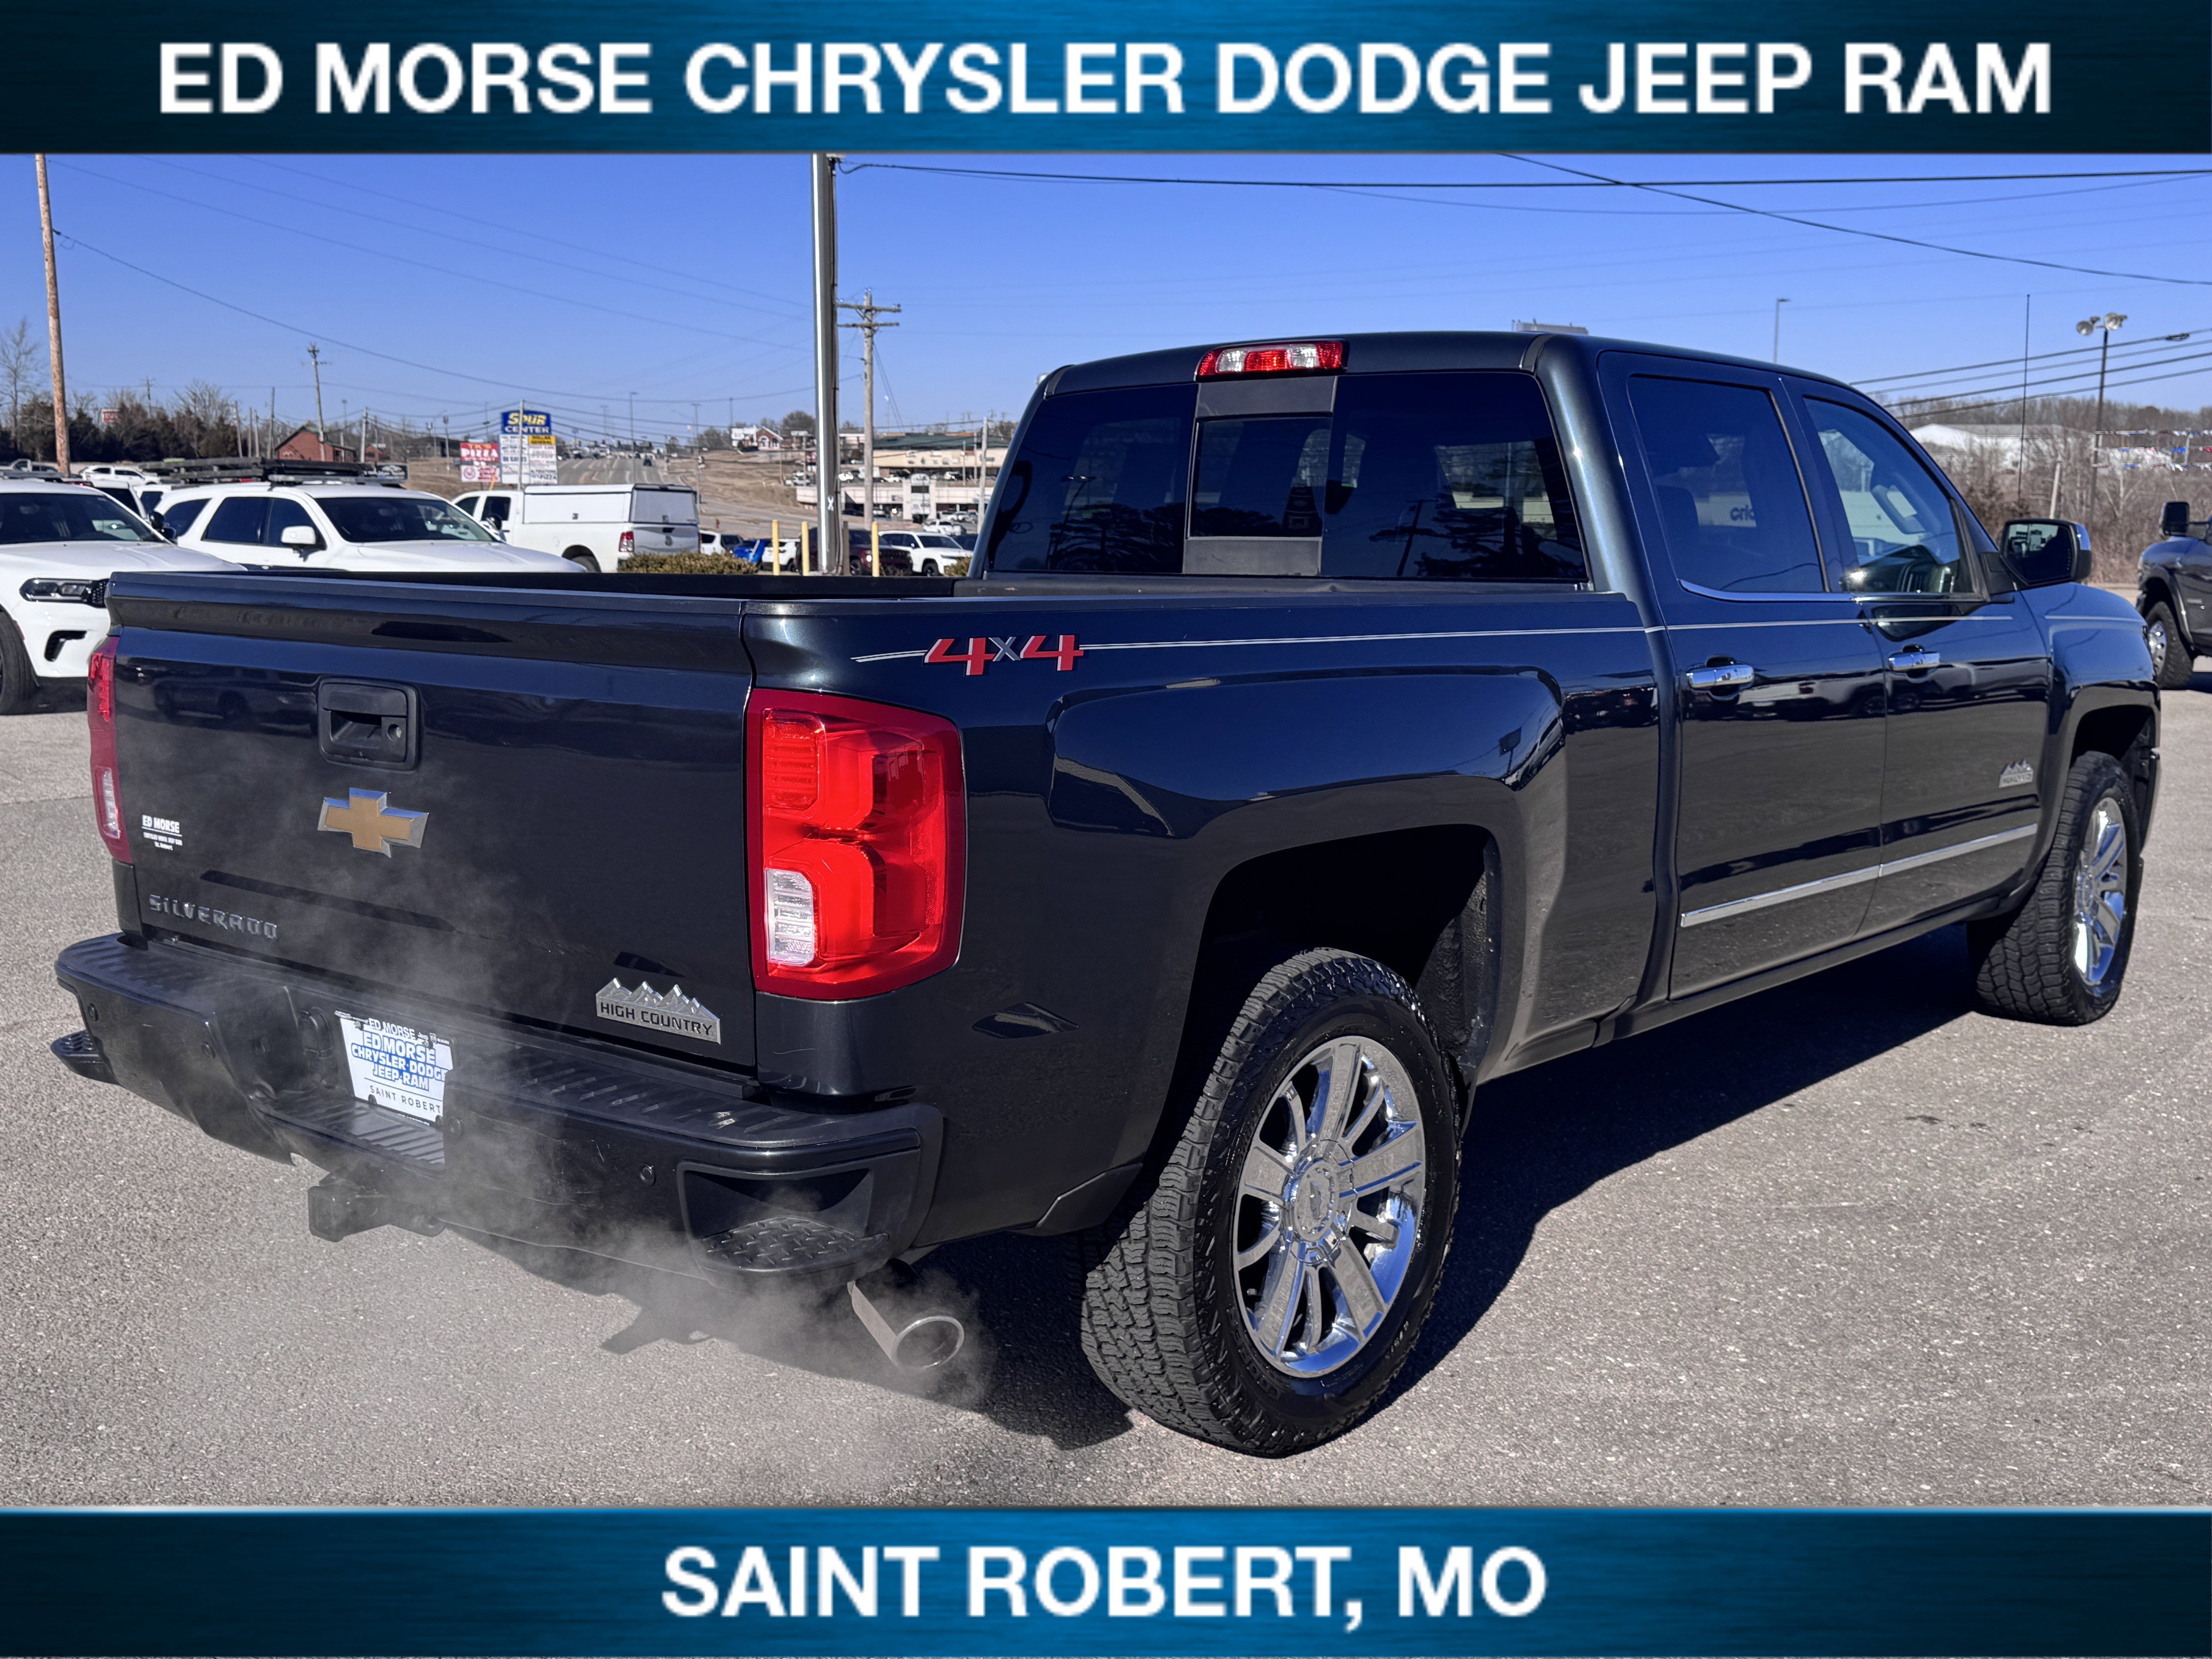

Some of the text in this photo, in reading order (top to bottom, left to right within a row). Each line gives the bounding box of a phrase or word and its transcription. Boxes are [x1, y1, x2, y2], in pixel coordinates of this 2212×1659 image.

[460, 448, 498, 457] PIZZA
[142, 815, 180, 833] ED MORSE
[149, 894, 277, 939] SILVERADO
[369, 1018, 381, 1030] ED
[383, 1021, 416, 1040] MORSE
[601, 1002, 712, 1036] HIGH COUNTRY
[363, 1031, 436, 1065] ED MORSE
[370, 1085, 440, 1113] SAINT ROBERT
